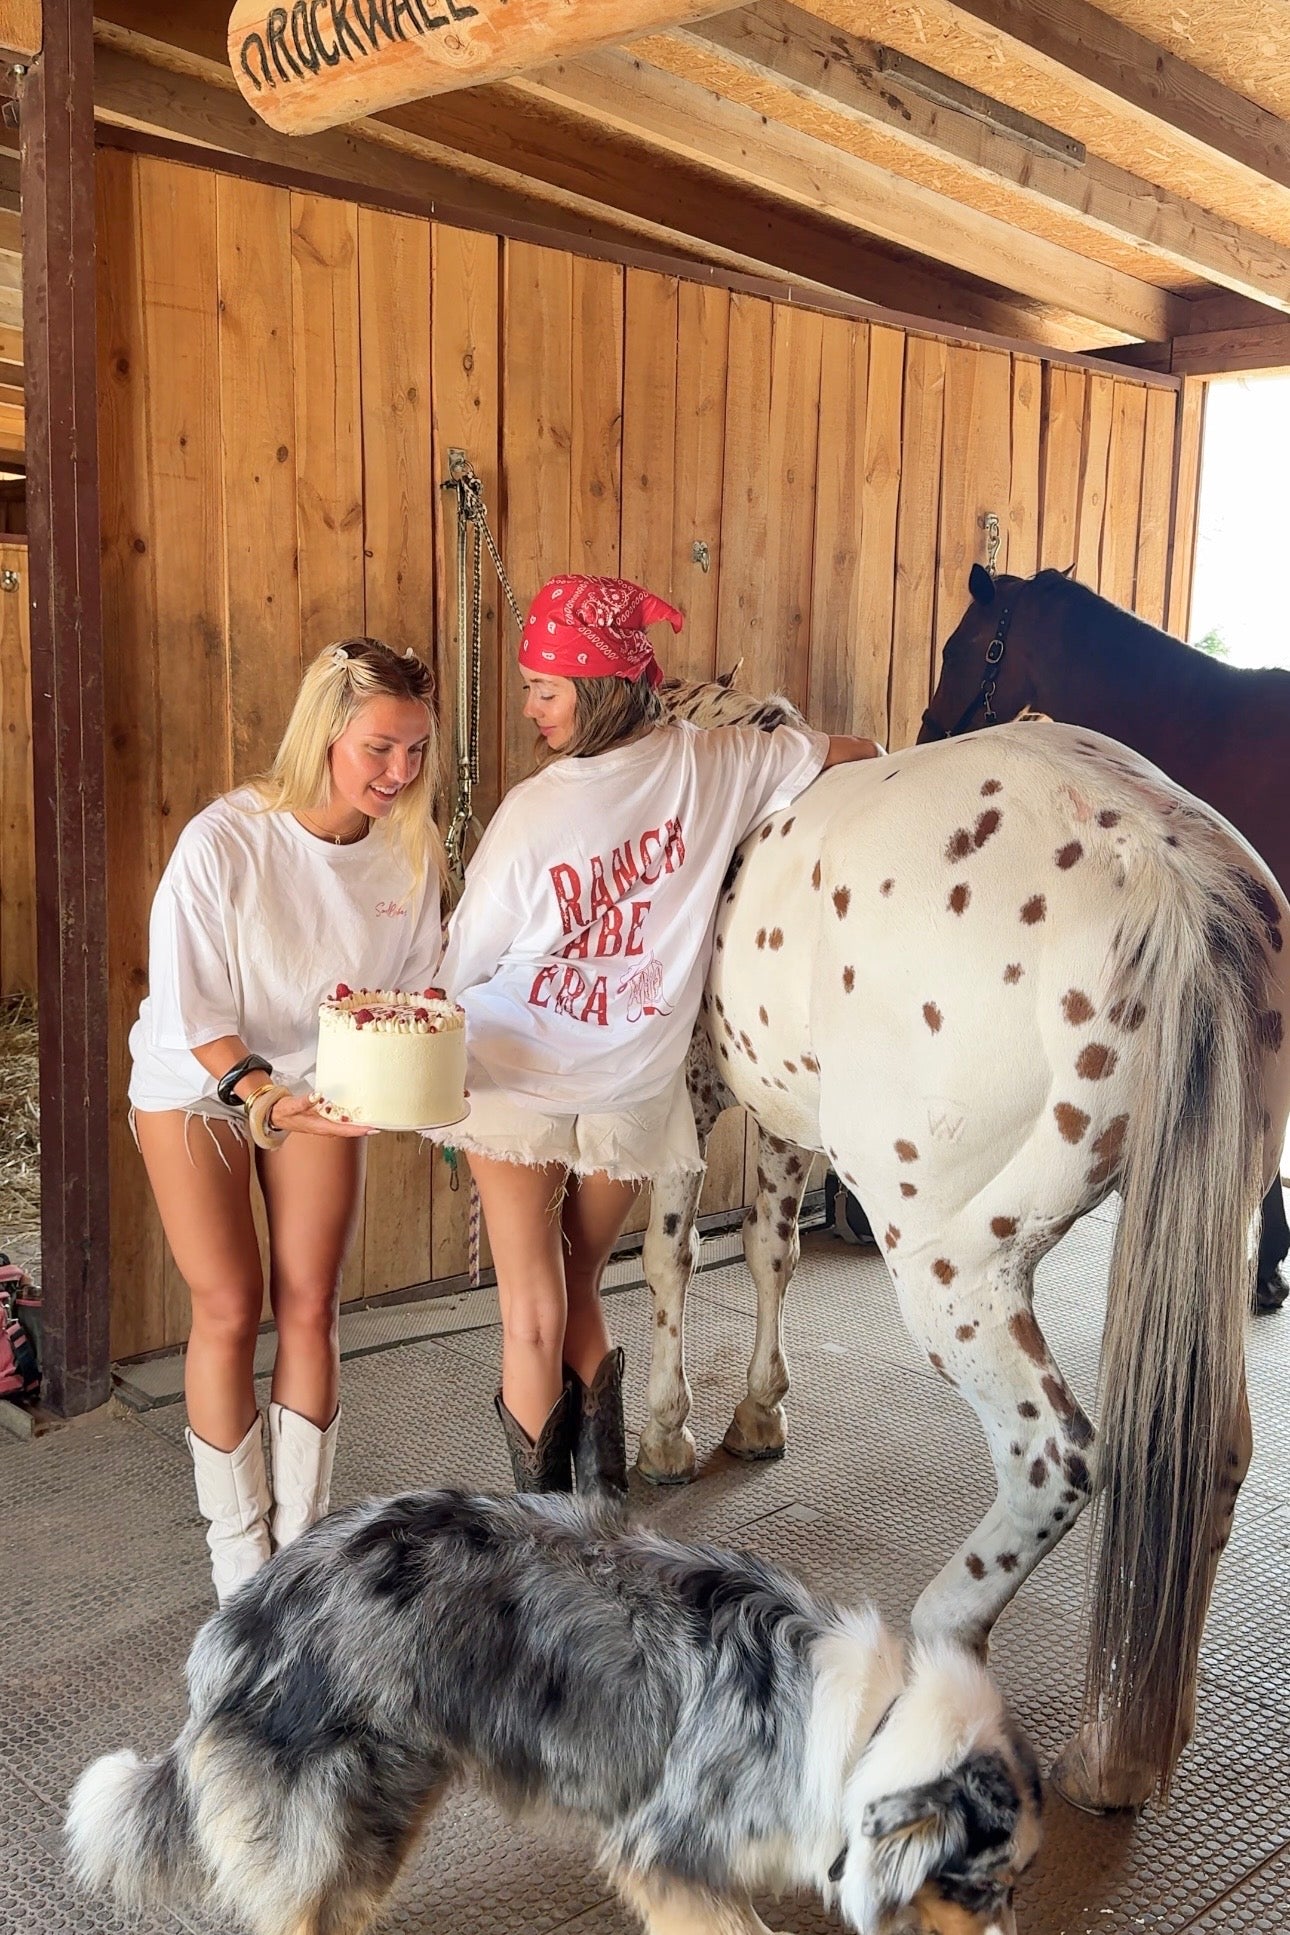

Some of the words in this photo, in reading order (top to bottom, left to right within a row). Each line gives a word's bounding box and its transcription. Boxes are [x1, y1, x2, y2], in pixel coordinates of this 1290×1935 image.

[549, 816, 686, 936] RANCH
[561, 901, 652, 959] ABE
[528, 963, 609, 1026] ERA
